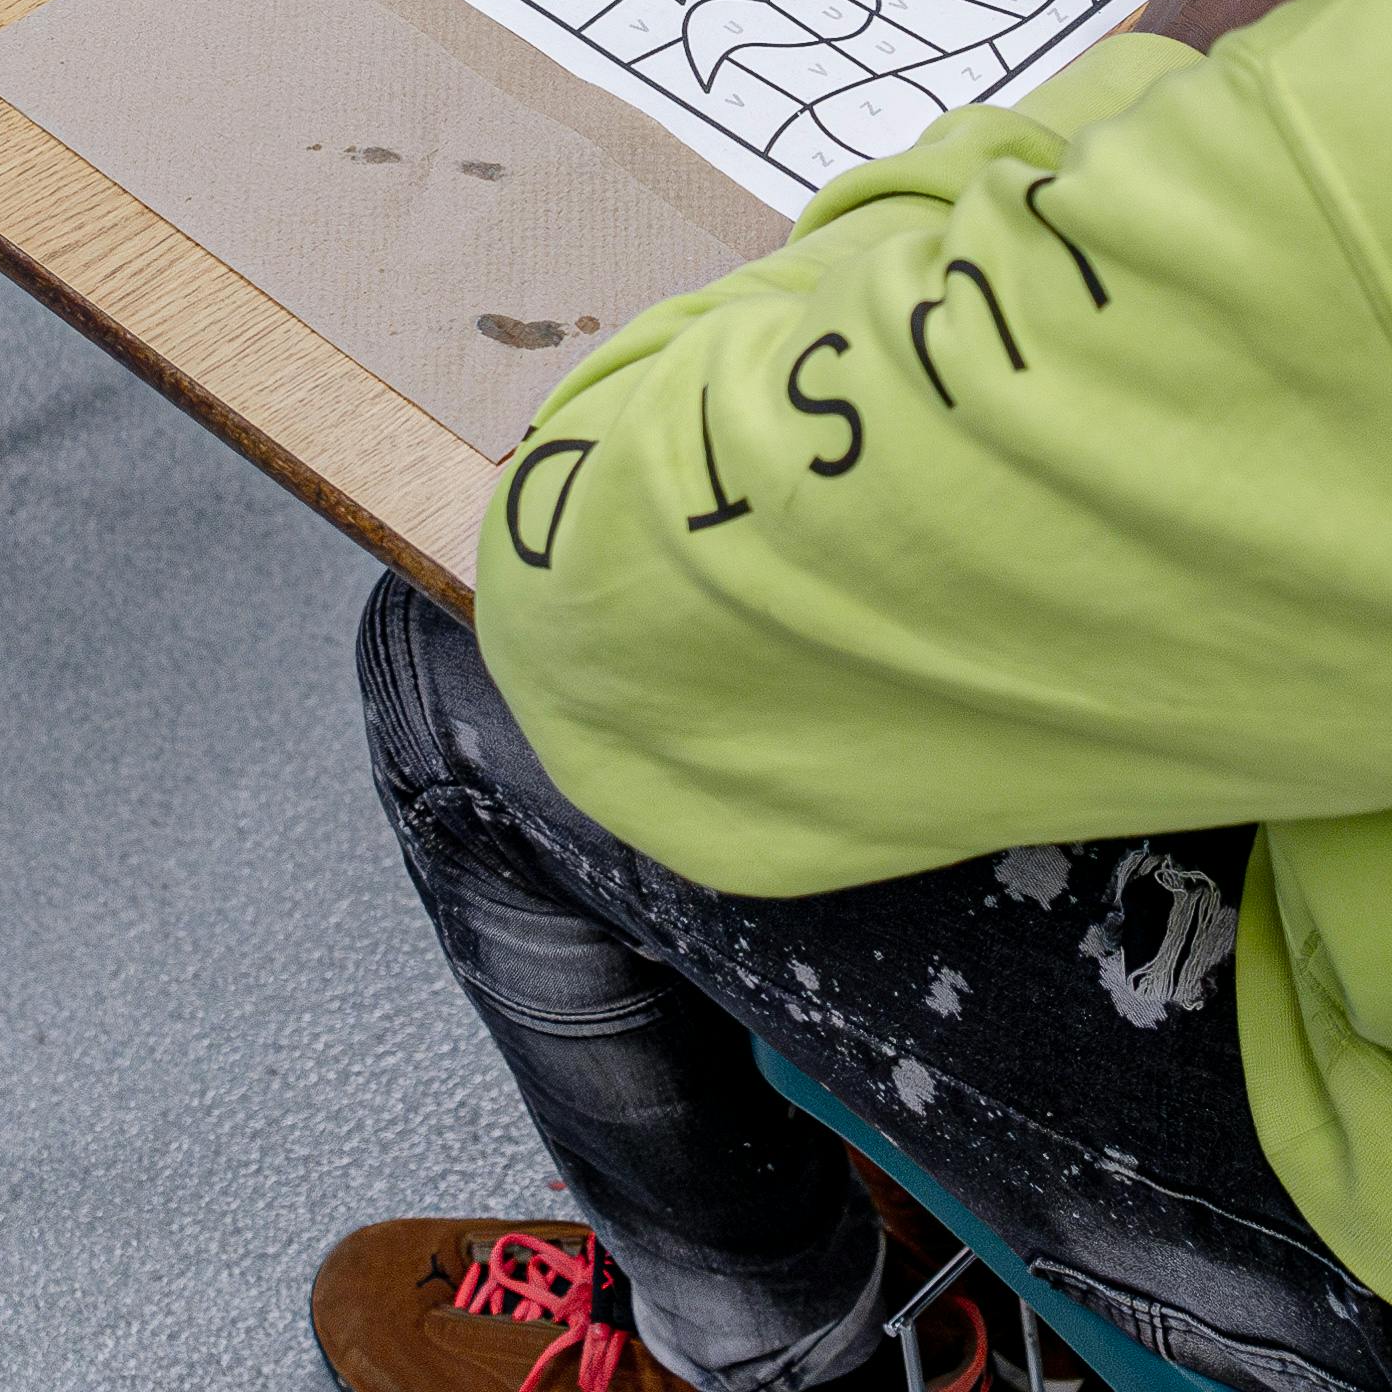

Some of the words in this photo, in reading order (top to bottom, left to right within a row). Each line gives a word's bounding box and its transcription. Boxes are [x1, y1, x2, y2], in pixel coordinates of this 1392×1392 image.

[822, 6, 843, 20] U
[1047, 8, 1069, 23] Z
[629, 19, 649, 32] V
[723, 21, 743, 34] U
[875, 41, 896, 54] U
[808, 64, 827, 76] V
[961, 67, 982, 81] Z
[725, 94, 745, 107] V
[860, 101, 882, 116] Z
[812, 152, 834, 167] Z
[687, 175, 1109, 533] JUST
[505, 424, 598, 571] D
